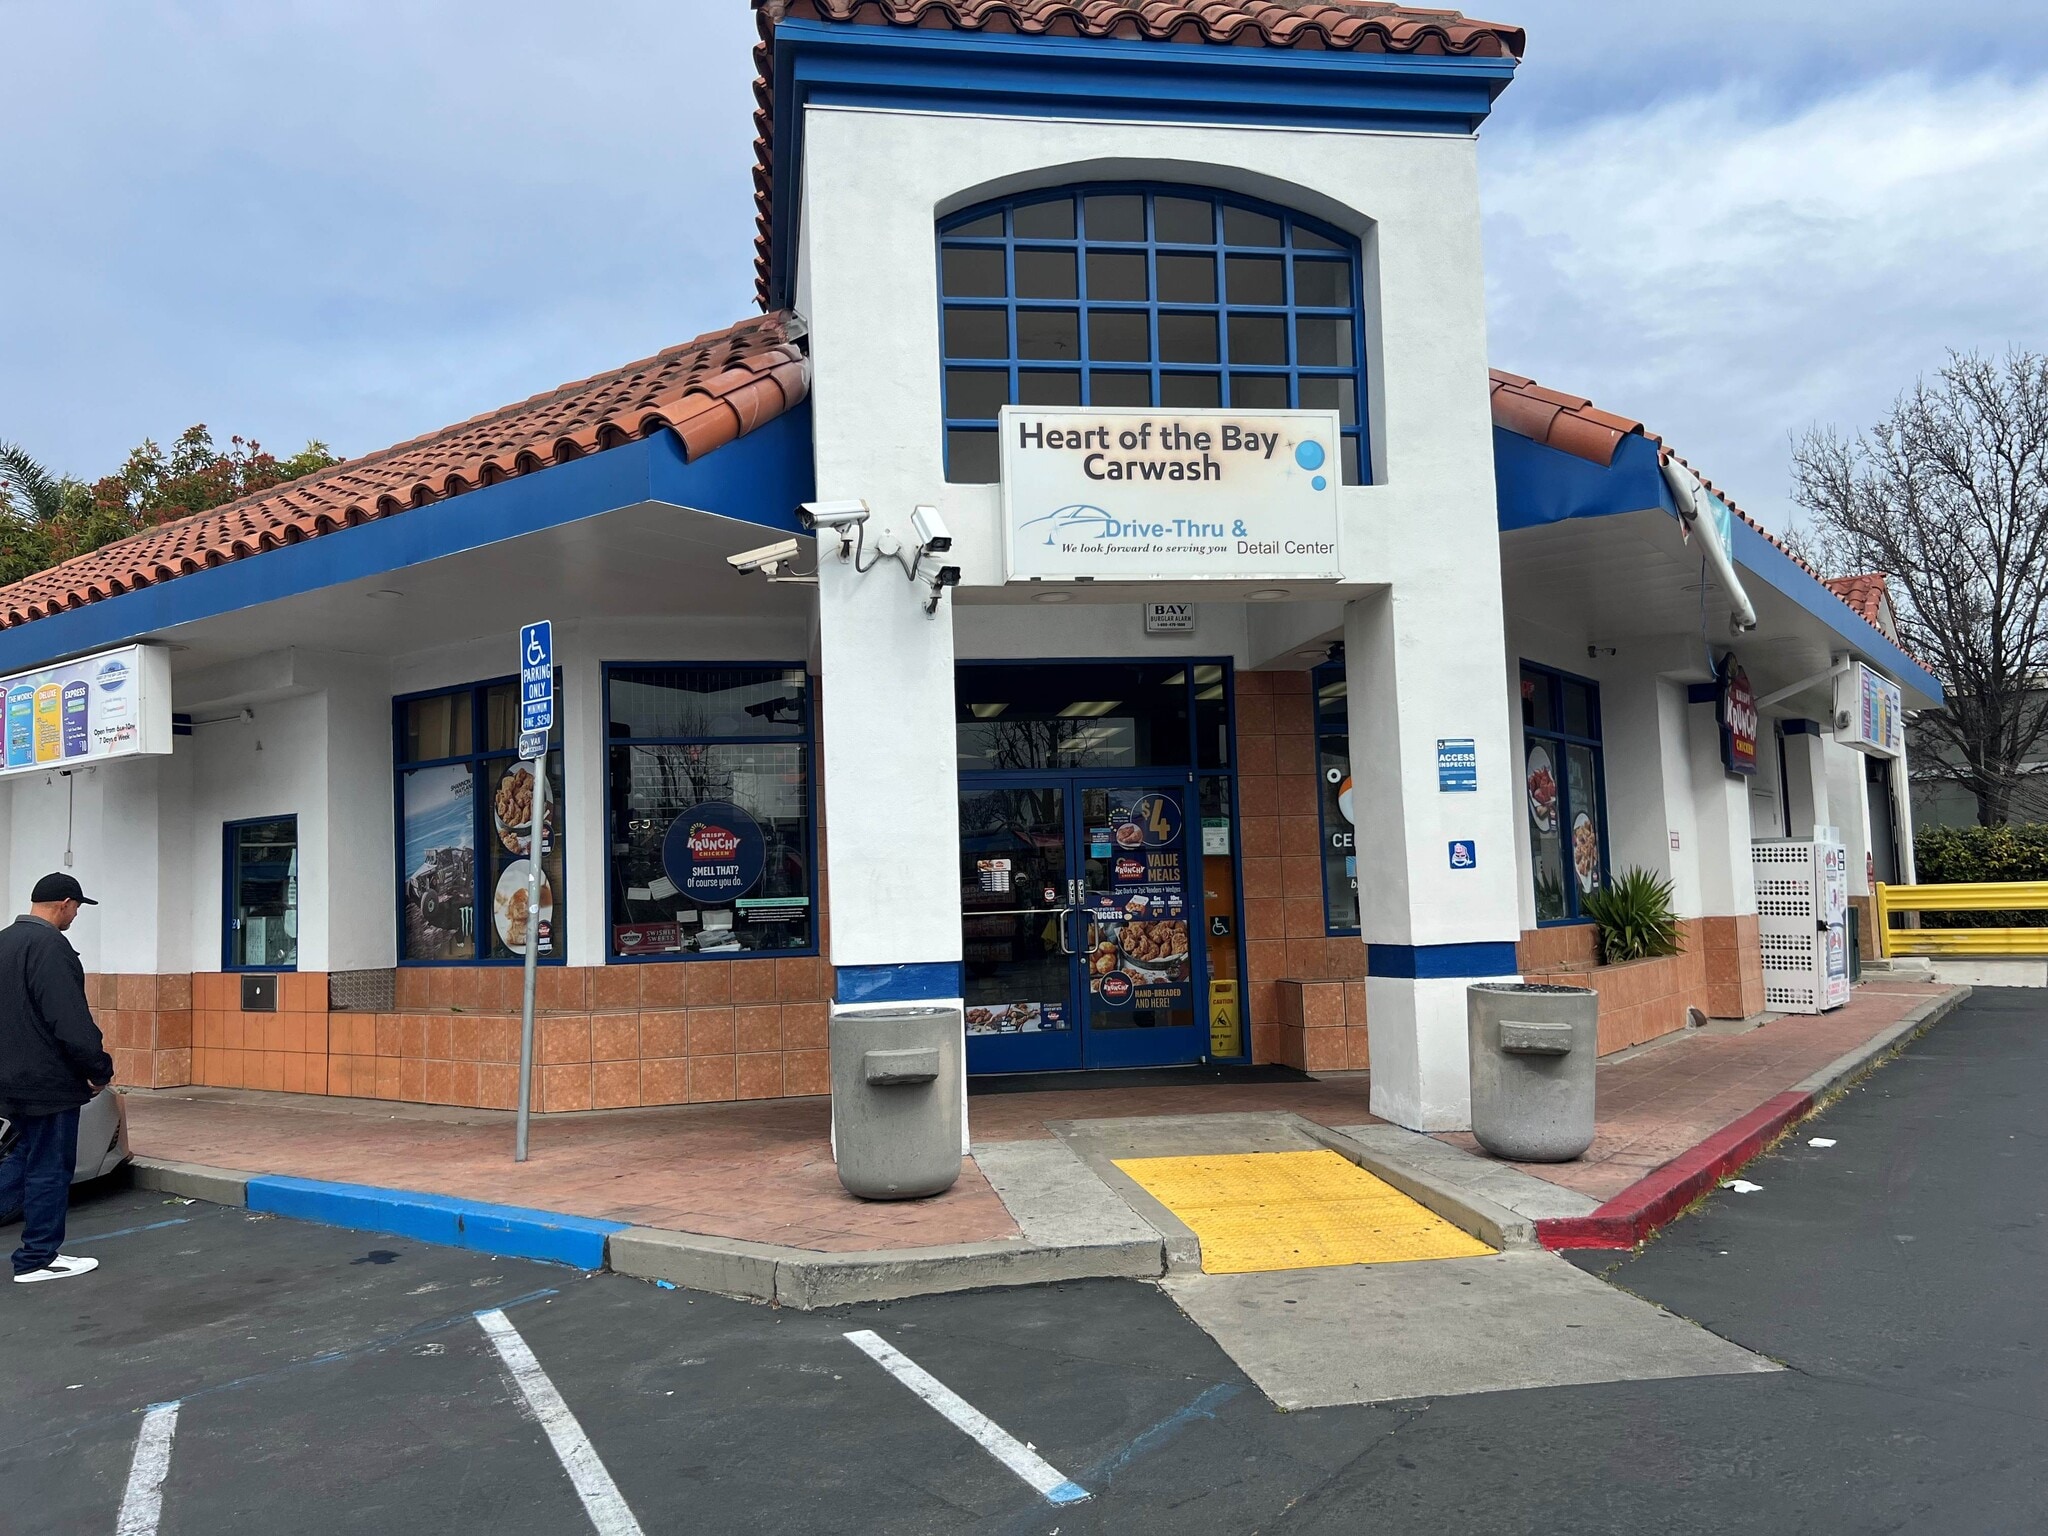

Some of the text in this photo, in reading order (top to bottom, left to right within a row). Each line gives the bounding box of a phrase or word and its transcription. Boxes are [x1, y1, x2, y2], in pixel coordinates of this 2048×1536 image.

[1019, 422, 1279, 459] Heart of the Bay
[1083, 453, 1222, 481] Carwash
[1105, 518, 1249, 538] Drive-Thru &
[1062, 543, 1228, 555] We look forward to serving you
[1237, 541, 1335, 554] Detail Center
[1155, 605, 1188, 615] BAY
[523, 663, 551, 683] PARKING
[64, 687, 86, 699] EXPRESS
[528, 682, 546, 699] ONLY
[527, 702, 547, 715] MINIMUM
[524, 714, 551, 728] FINE $250
[94, 728, 106, 737] Open
[106, 725, 116, 733] from
[118, 733, 130, 742] Week
[1736, 739, 1754, 756] CHICKEN
[687, 837, 741, 851] KRUNCHY
[1147, 854, 1179, 867] VALUE
[692, 865, 739, 876] SMELL THAT?
[1115, 866, 1146, 874] KRUNCHY
[1147, 868, 1181, 882] MEALS
[687, 875, 743, 890] Of course you do.
[1097, 911, 1122, 919] UGGETS
[1134, 988, 1181, 998] HAND-BREADED
[1135, 997, 1170, 1008] AND HERE!
